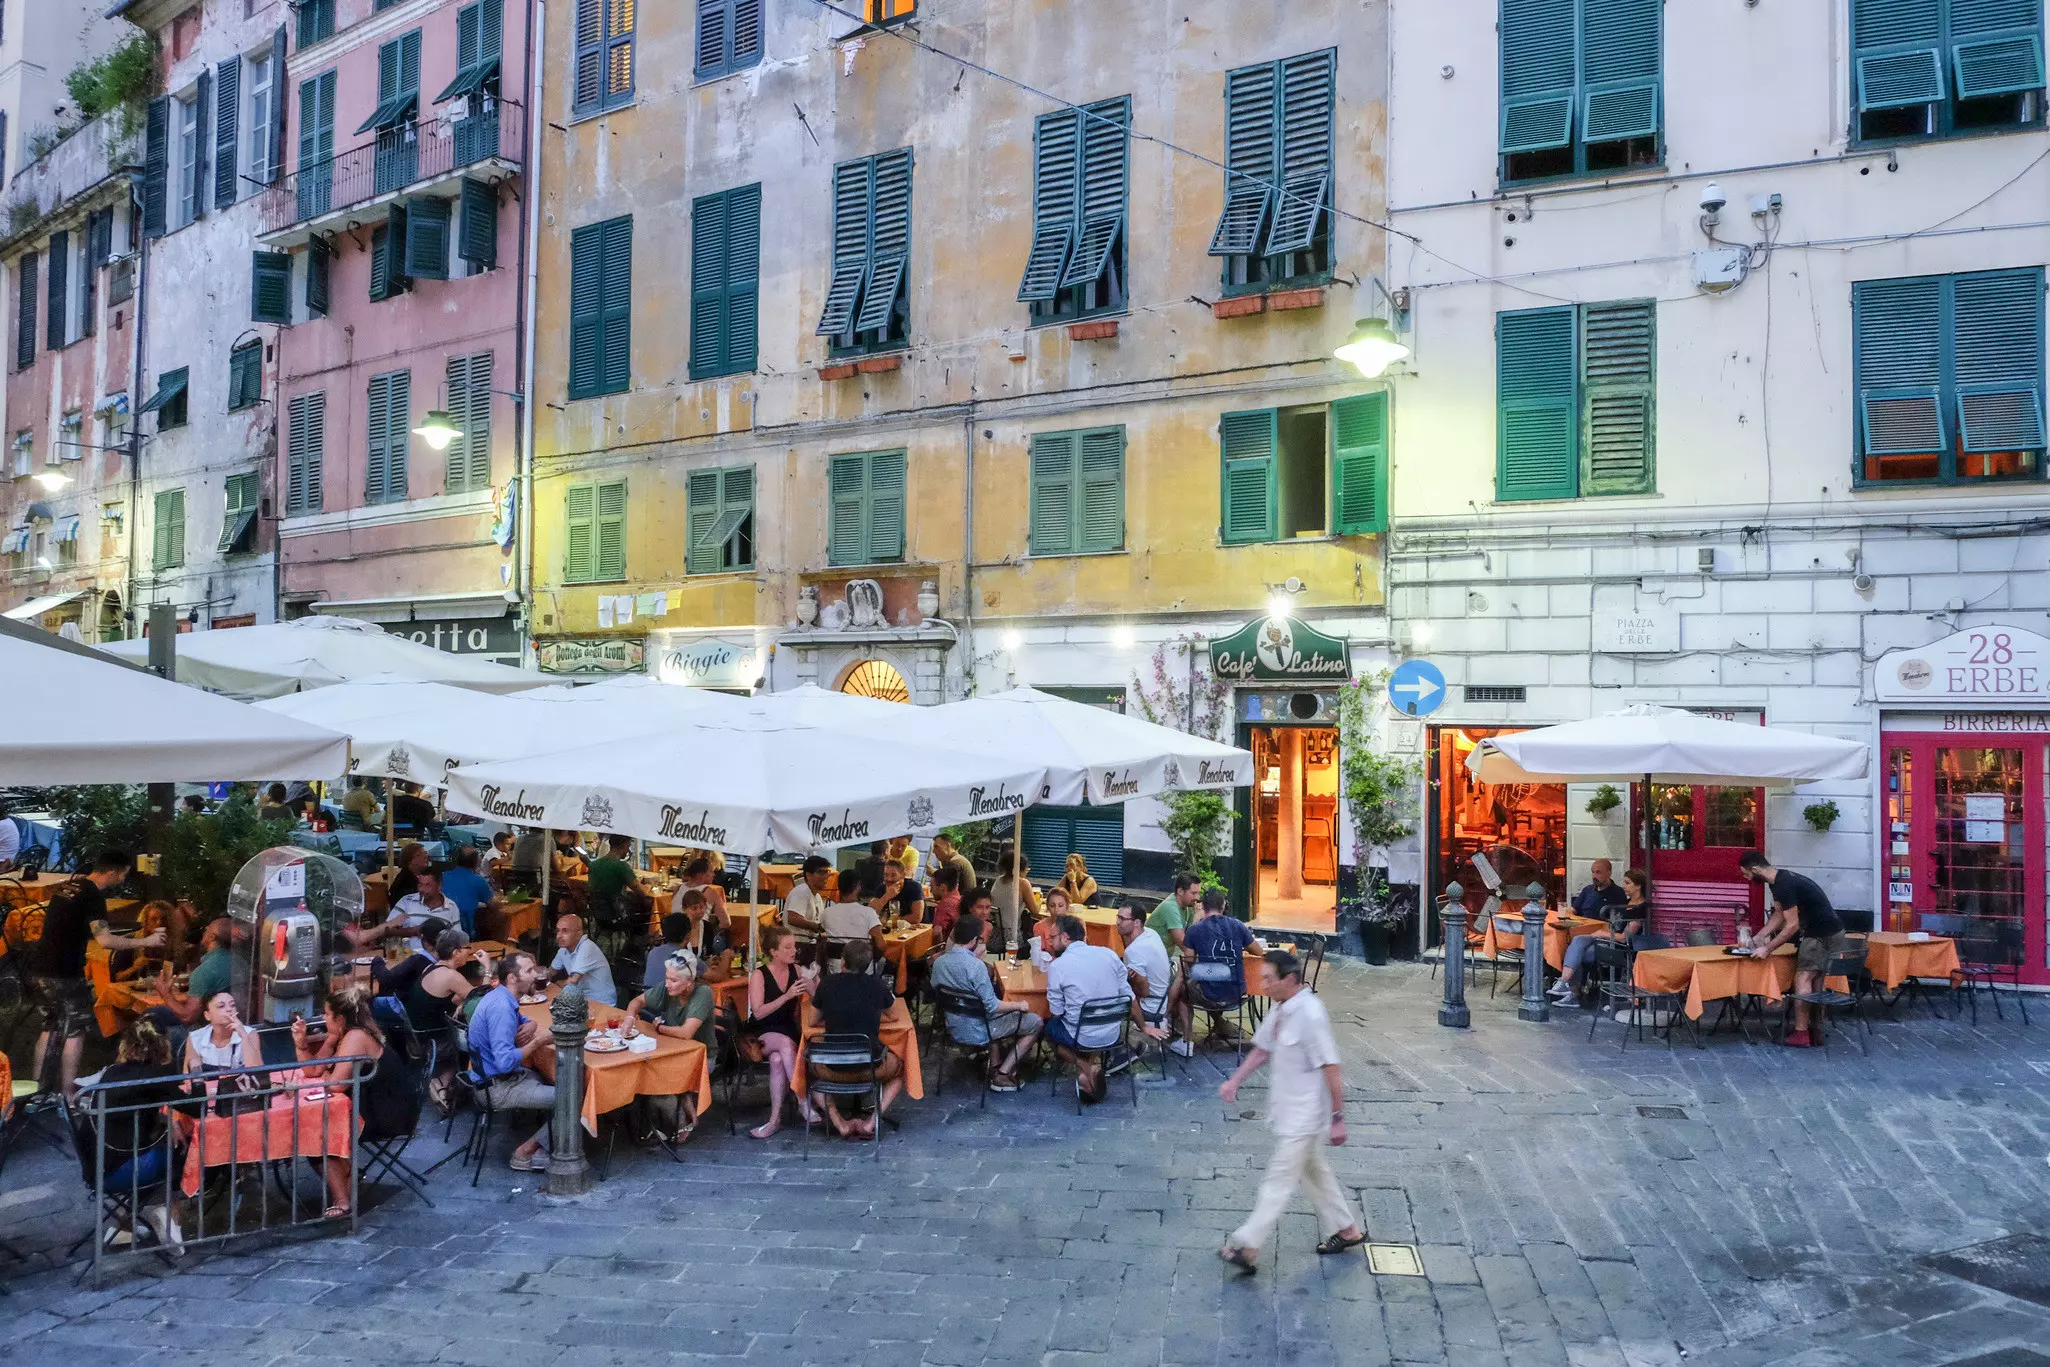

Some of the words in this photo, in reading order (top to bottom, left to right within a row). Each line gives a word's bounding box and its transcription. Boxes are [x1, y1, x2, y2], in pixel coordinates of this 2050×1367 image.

[391, 622, 488, 651] etta
[1617, 618, 1655, 628] PIAZZA
[555, 644, 583, 662] Bottega
[584, 646, 603, 659] degli
[604, 642, 626, 661] Aromi
[1619, 634, 1653, 645] ERBE
[1968, 633, 2013, 665] 28
[664, 647, 731, 679] Biggie
[1286, 650, 1346, 673] Latino
[1946, 667, 2039, 693] ERBE
[1943, 715, 2049, 731] BIRRERIA
[1102, 768, 1139, 800] Menabrea
[1196, 759, 1235, 785] Menabrea
[480, 783, 545, 822] Menabrea
[967, 782, 1025, 818] Menabrea
[656, 803, 727, 847] Menabrea
[806, 807, 870, 848] Menabrea
